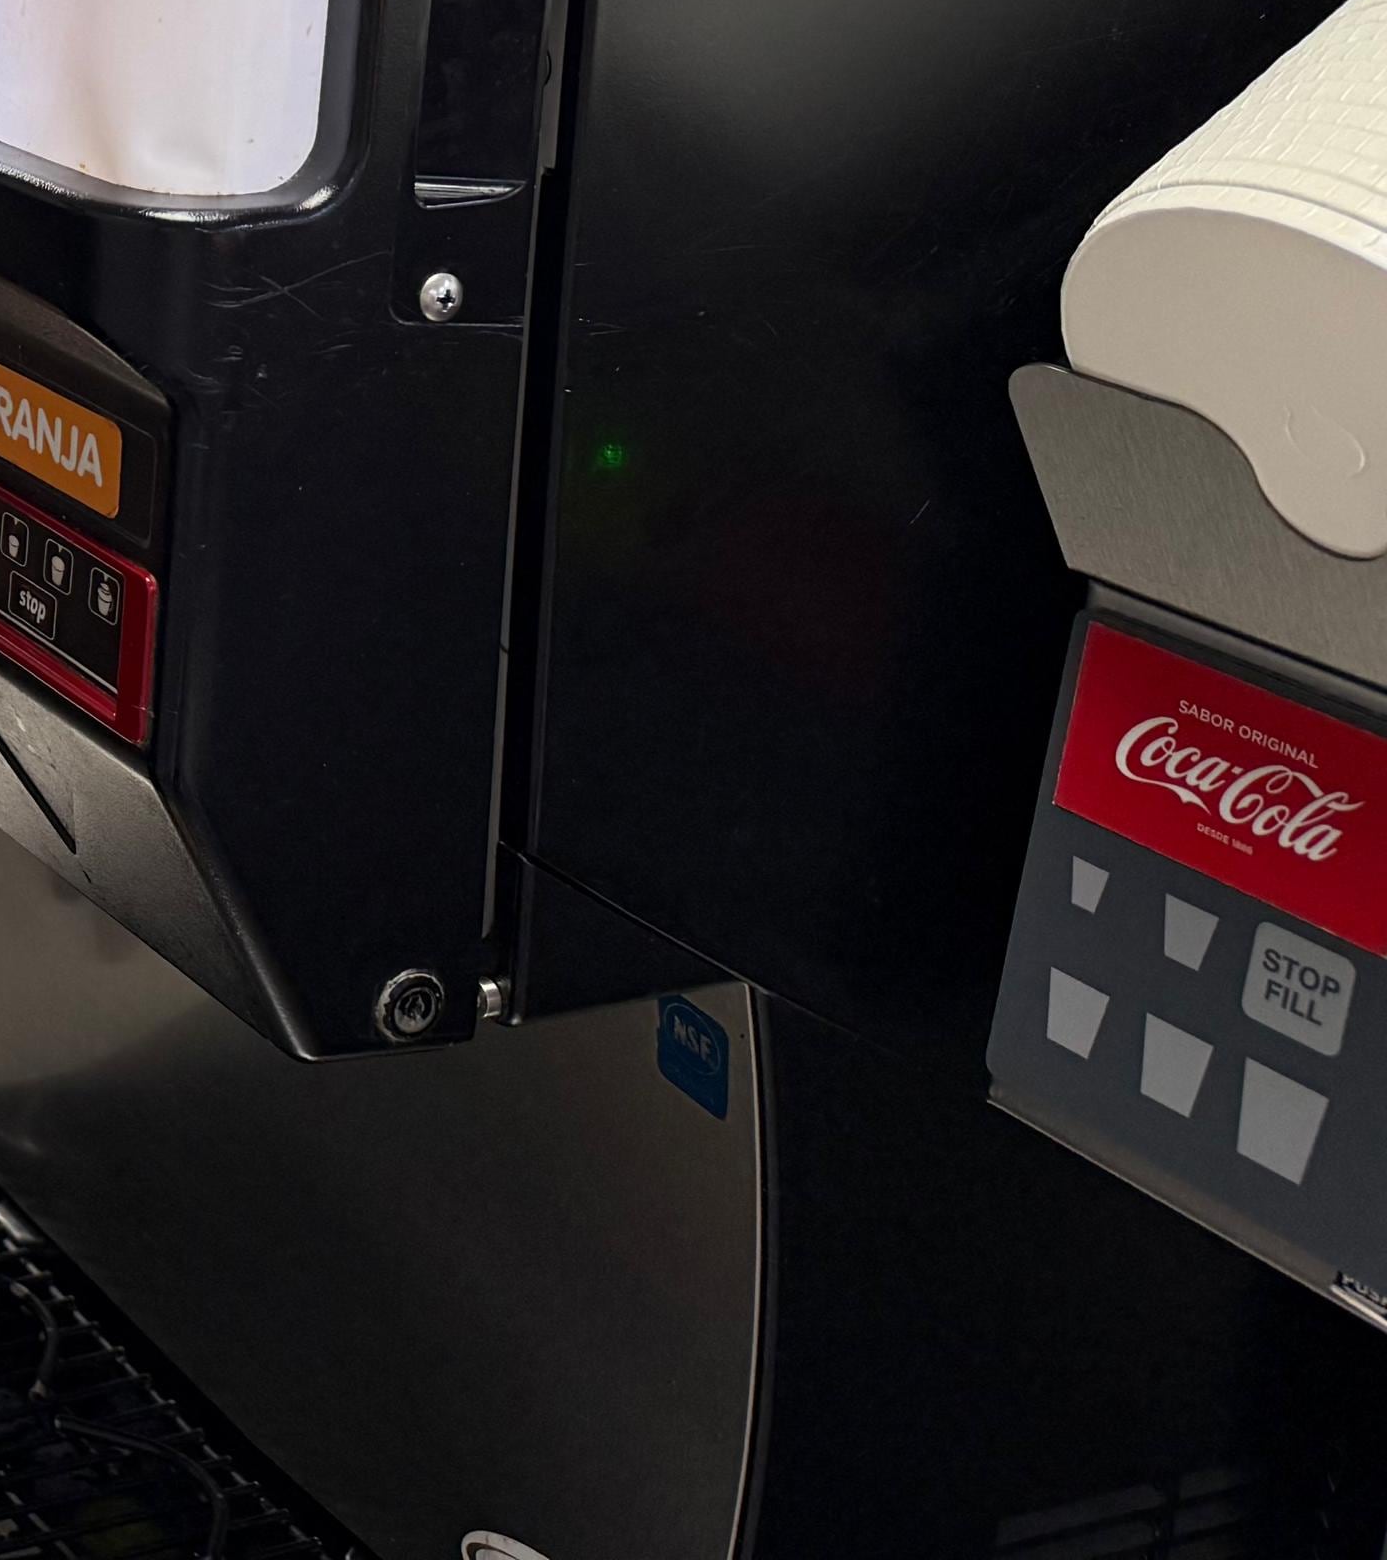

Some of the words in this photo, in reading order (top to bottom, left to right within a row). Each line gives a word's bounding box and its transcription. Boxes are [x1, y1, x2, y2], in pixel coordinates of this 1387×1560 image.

[18, 590, 46, 624] stop
[1178, 699, 1235, 734] SABOR
[1238, 724, 1319, 770] ORIGINAL
[1114, 715, 1366, 862] Coca-Cola
[1196, 822, 1230, 846] DESDE
[1262, 947, 1341, 998] STOP
[1264, 977, 1324, 1027] FILL
